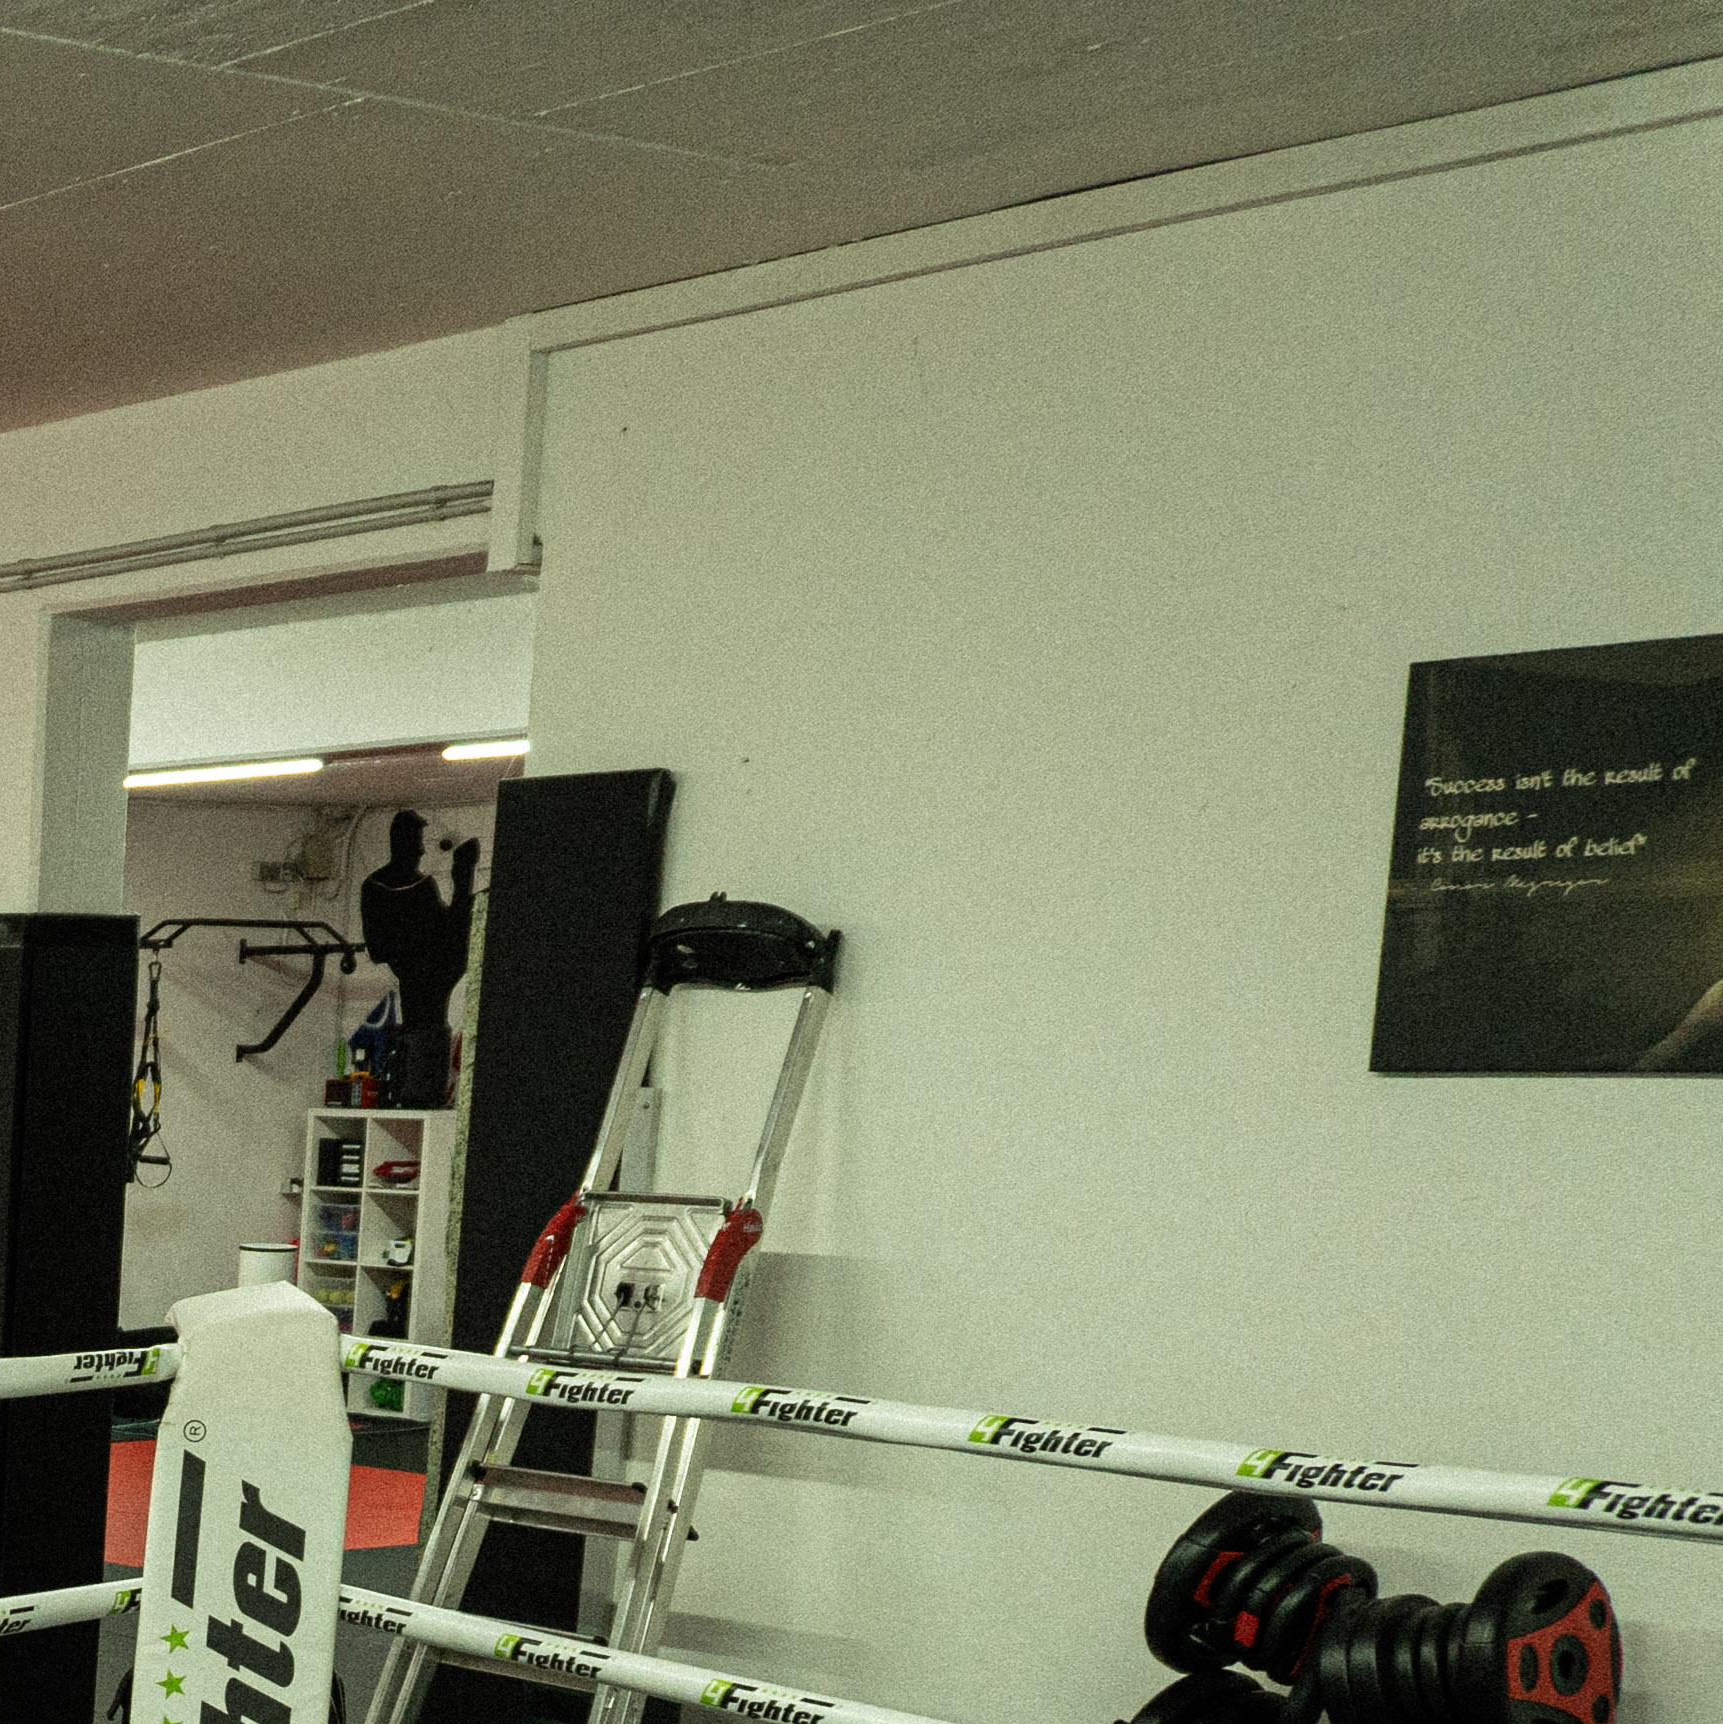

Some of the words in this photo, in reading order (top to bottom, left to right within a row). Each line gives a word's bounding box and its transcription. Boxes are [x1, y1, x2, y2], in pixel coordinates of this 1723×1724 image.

[1562, 768, 1596, 787] the
[1605, 762, 1663, 785] result
[1672, 757, 1697, 780] of
[1418, 811, 1519, 843] arrogance
[1451, 845, 1483, 862] the
[1491, 840, 1547, 861] result
[1555, 836, 1579, 857] of
[1546, 1477, 1723, 1527] 4Fighte
